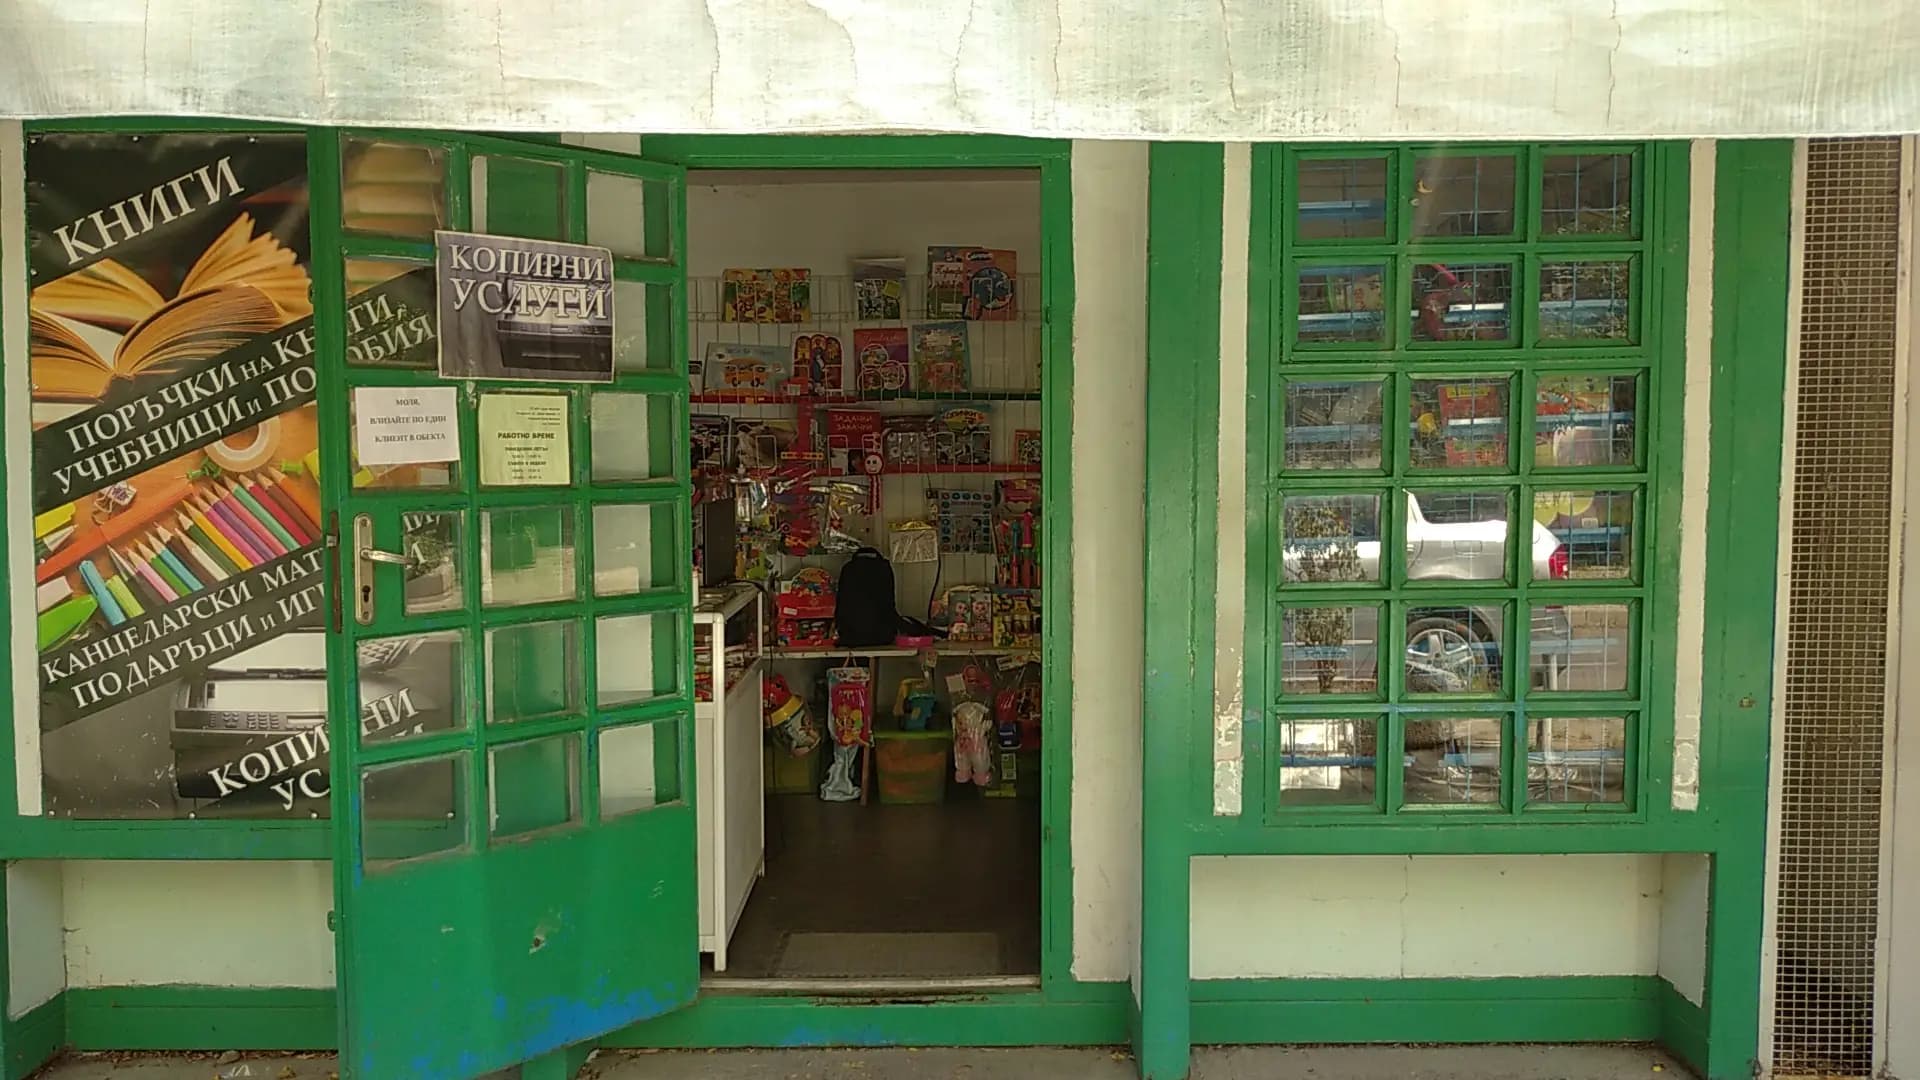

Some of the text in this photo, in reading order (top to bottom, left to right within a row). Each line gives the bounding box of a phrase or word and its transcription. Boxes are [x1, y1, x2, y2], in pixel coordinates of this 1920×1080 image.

[53, 156, 245, 265] КНИГИ
[449, 244, 606, 281] КОПИРНИ
[450, 278, 608, 319] УСЛУГИ
[52, 396, 248, 496] УЧЕБНИЦИ
[65, 361, 240, 454] ПОРЪЧКИ
[369, 415, 446, 425] ВЛИЗАЙТЕ ПО ЕДИН
[375, 434, 408, 442] КЛИЕНТ
[416, 432, 446, 441] ОБЕКТА
[42, 580, 252, 685] КАНЦЕЛАРСКИ
[70, 620, 256, 709] ПОДАРЪЦИ
[208, 687, 419, 797] КОПИНИ
